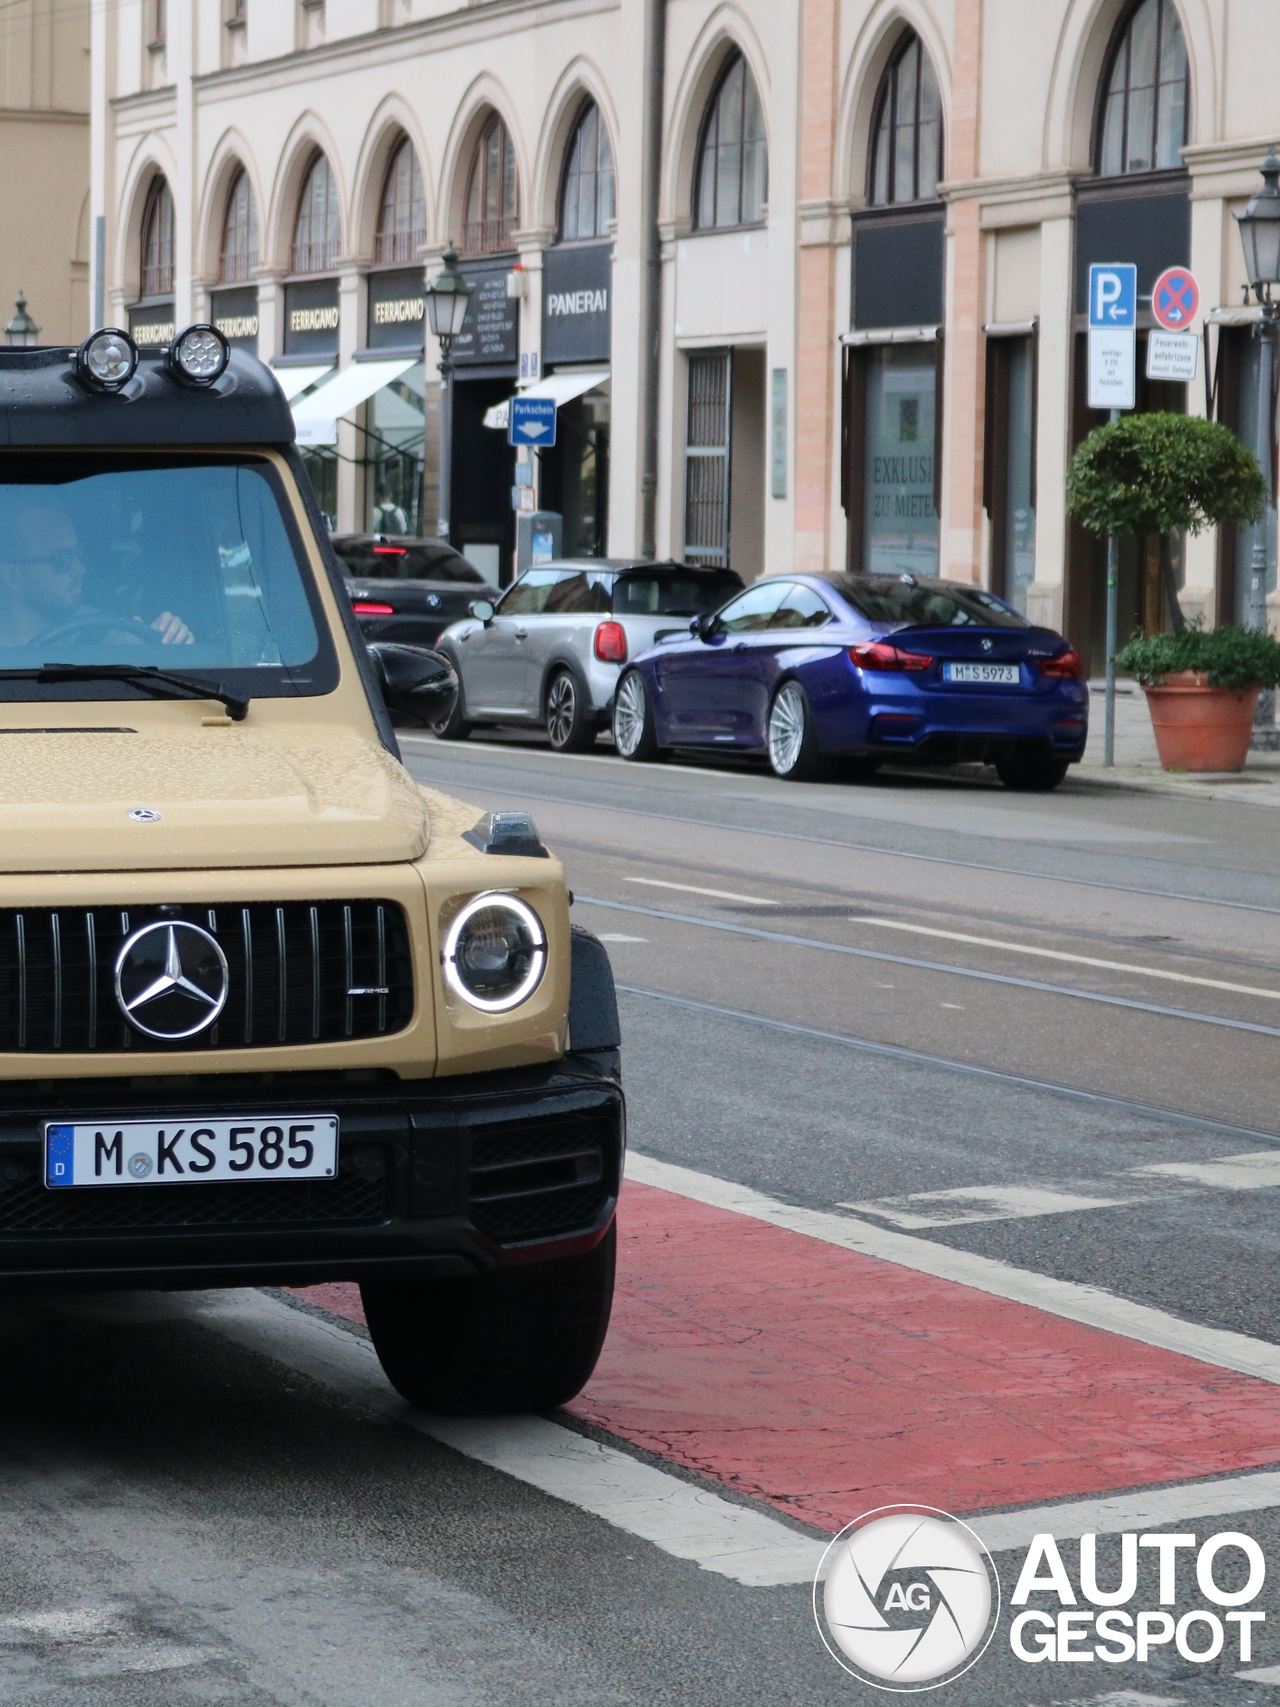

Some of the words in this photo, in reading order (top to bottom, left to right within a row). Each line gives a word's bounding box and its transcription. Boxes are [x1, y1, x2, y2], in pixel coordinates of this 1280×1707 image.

[547, 289, 608, 317] PANERAI
[1097, 272, 1122, 320] P
[290, 306, 339, 331] FERRAGAMO
[375, 299, 424, 324] FERRAGAMO
[134, 322, 175, 345] FERRAGAMO
[1156, 337, 1192, 349] Feuerwehr-
[1154, 351, 1191, 362] anfahrtzone
[514, 403, 554, 416] Parkschein
[874, 494, 890, 518] ZU
[955, 666, 964, 679] M
[972, 667, 980, 680] S
[982, 667, 1013, 681] 5973
[94, 1130, 123, 1176] M
[157, 1128, 217, 1174] KS
[228, 1125, 315, 1172] 585
[55, 1162, 65, 1176] D
